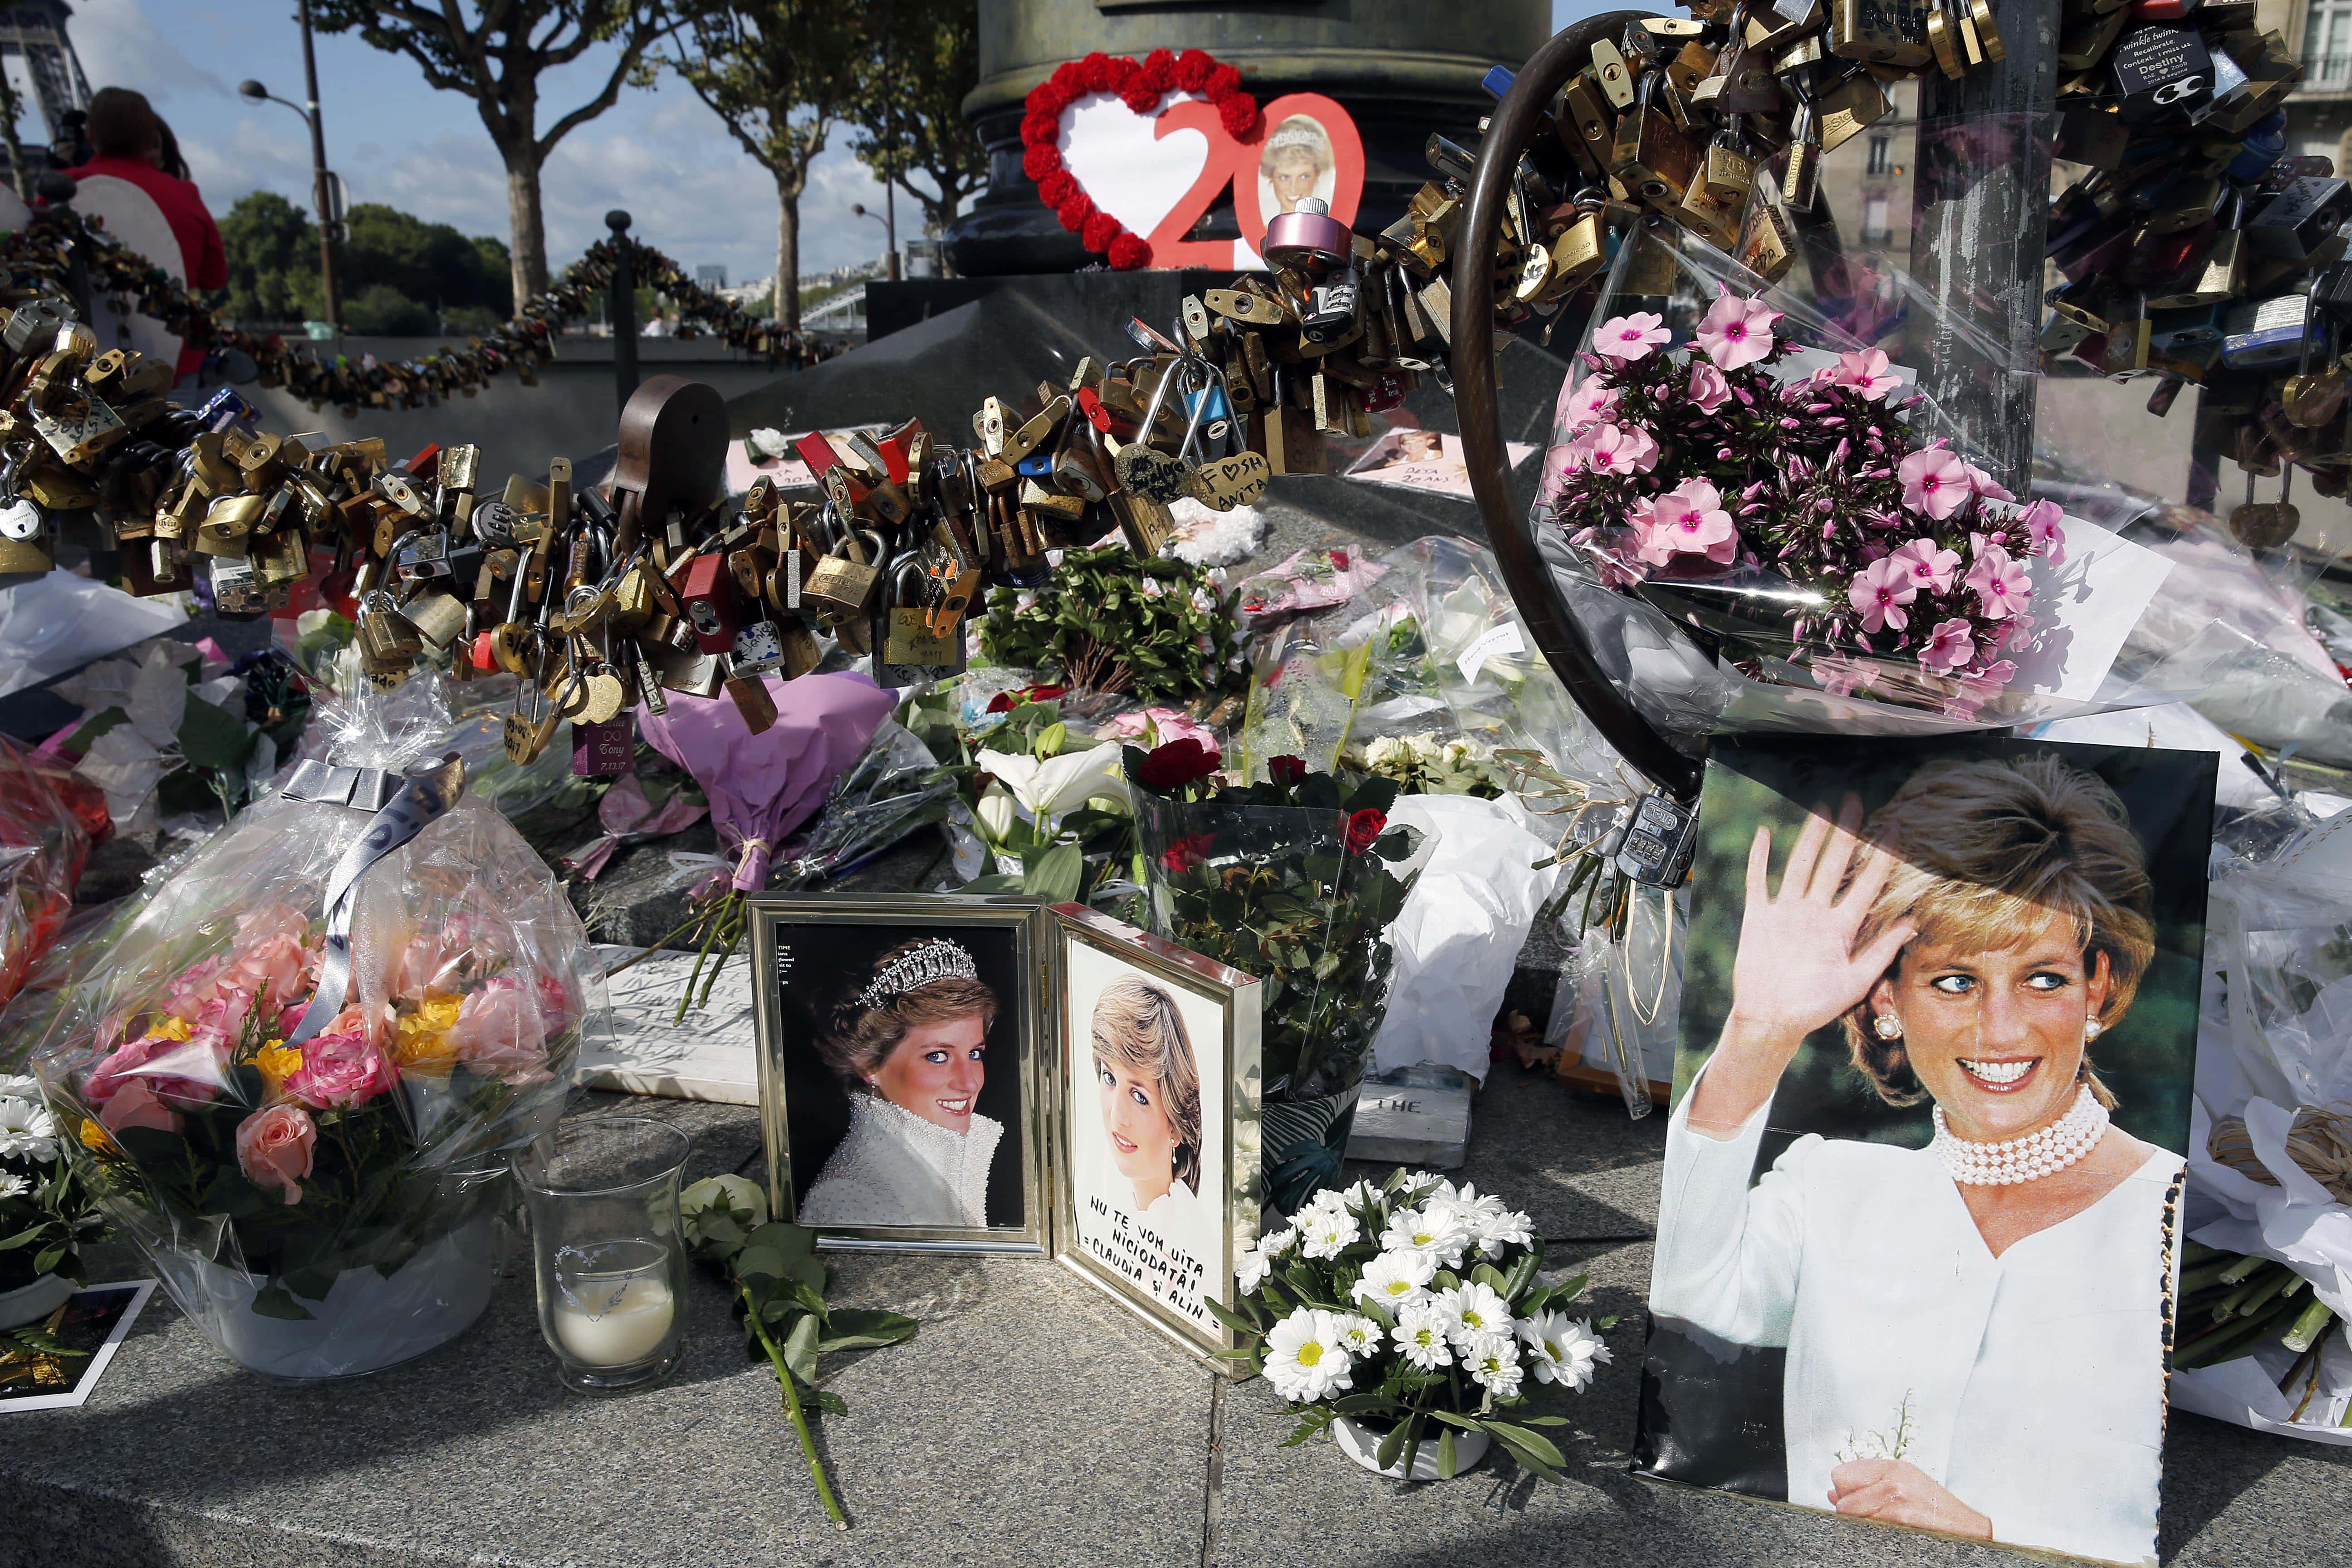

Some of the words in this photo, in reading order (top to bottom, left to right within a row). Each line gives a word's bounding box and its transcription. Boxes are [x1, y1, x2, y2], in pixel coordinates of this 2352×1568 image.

[2134, 39, 2176, 57] Recalibrate.
[2123, 55, 2155, 69] Context:
[2162, 47, 2180, 56] miss
[2139, 54, 2184, 75] Destiny
[2167, 68, 2187, 78] beyond
[1144, 92, 1365, 270] 20
[599, 744, 624, 757] Tony
[600, 762, 626, 771] 7.13.17
[1371, 1097, 1421, 1113] THE
[1090, 1195, 1107, 1216] NU
[1114, 1210, 1129, 1230] TE
[1138, 1225, 1163, 1252] VOM
